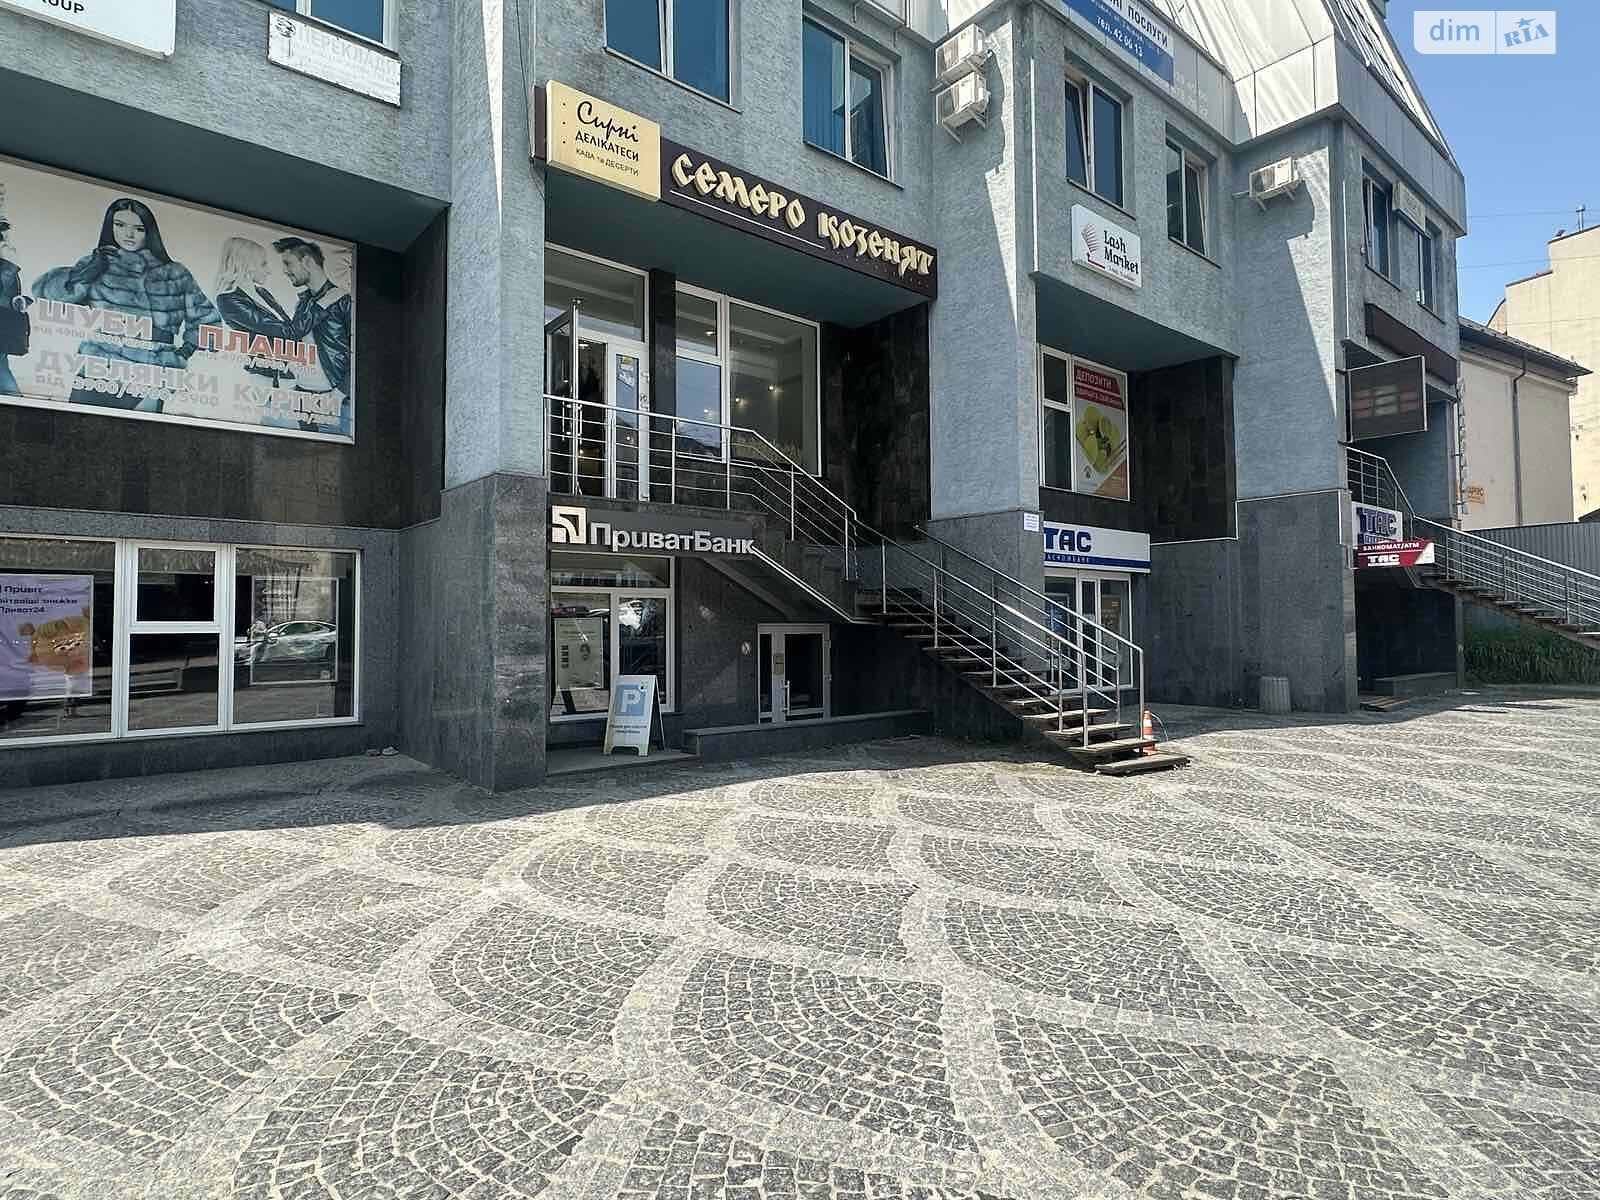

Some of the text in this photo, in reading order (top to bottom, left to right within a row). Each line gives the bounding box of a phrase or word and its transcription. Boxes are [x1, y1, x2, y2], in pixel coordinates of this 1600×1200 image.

[575, 129, 639, 162] ДЕЛІКАТЕСИ
[1103, 230, 1126, 253] Lash
[1103, 246, 1139, 275] Market
[38, 300, 153, 341] ШУБИ
[199, 325, 318, 367] ПЛАЩІ
[35, 351, 220, 394] ДУБЛЯНКИ
[590, 521, 755, 554] ПриватБанк
